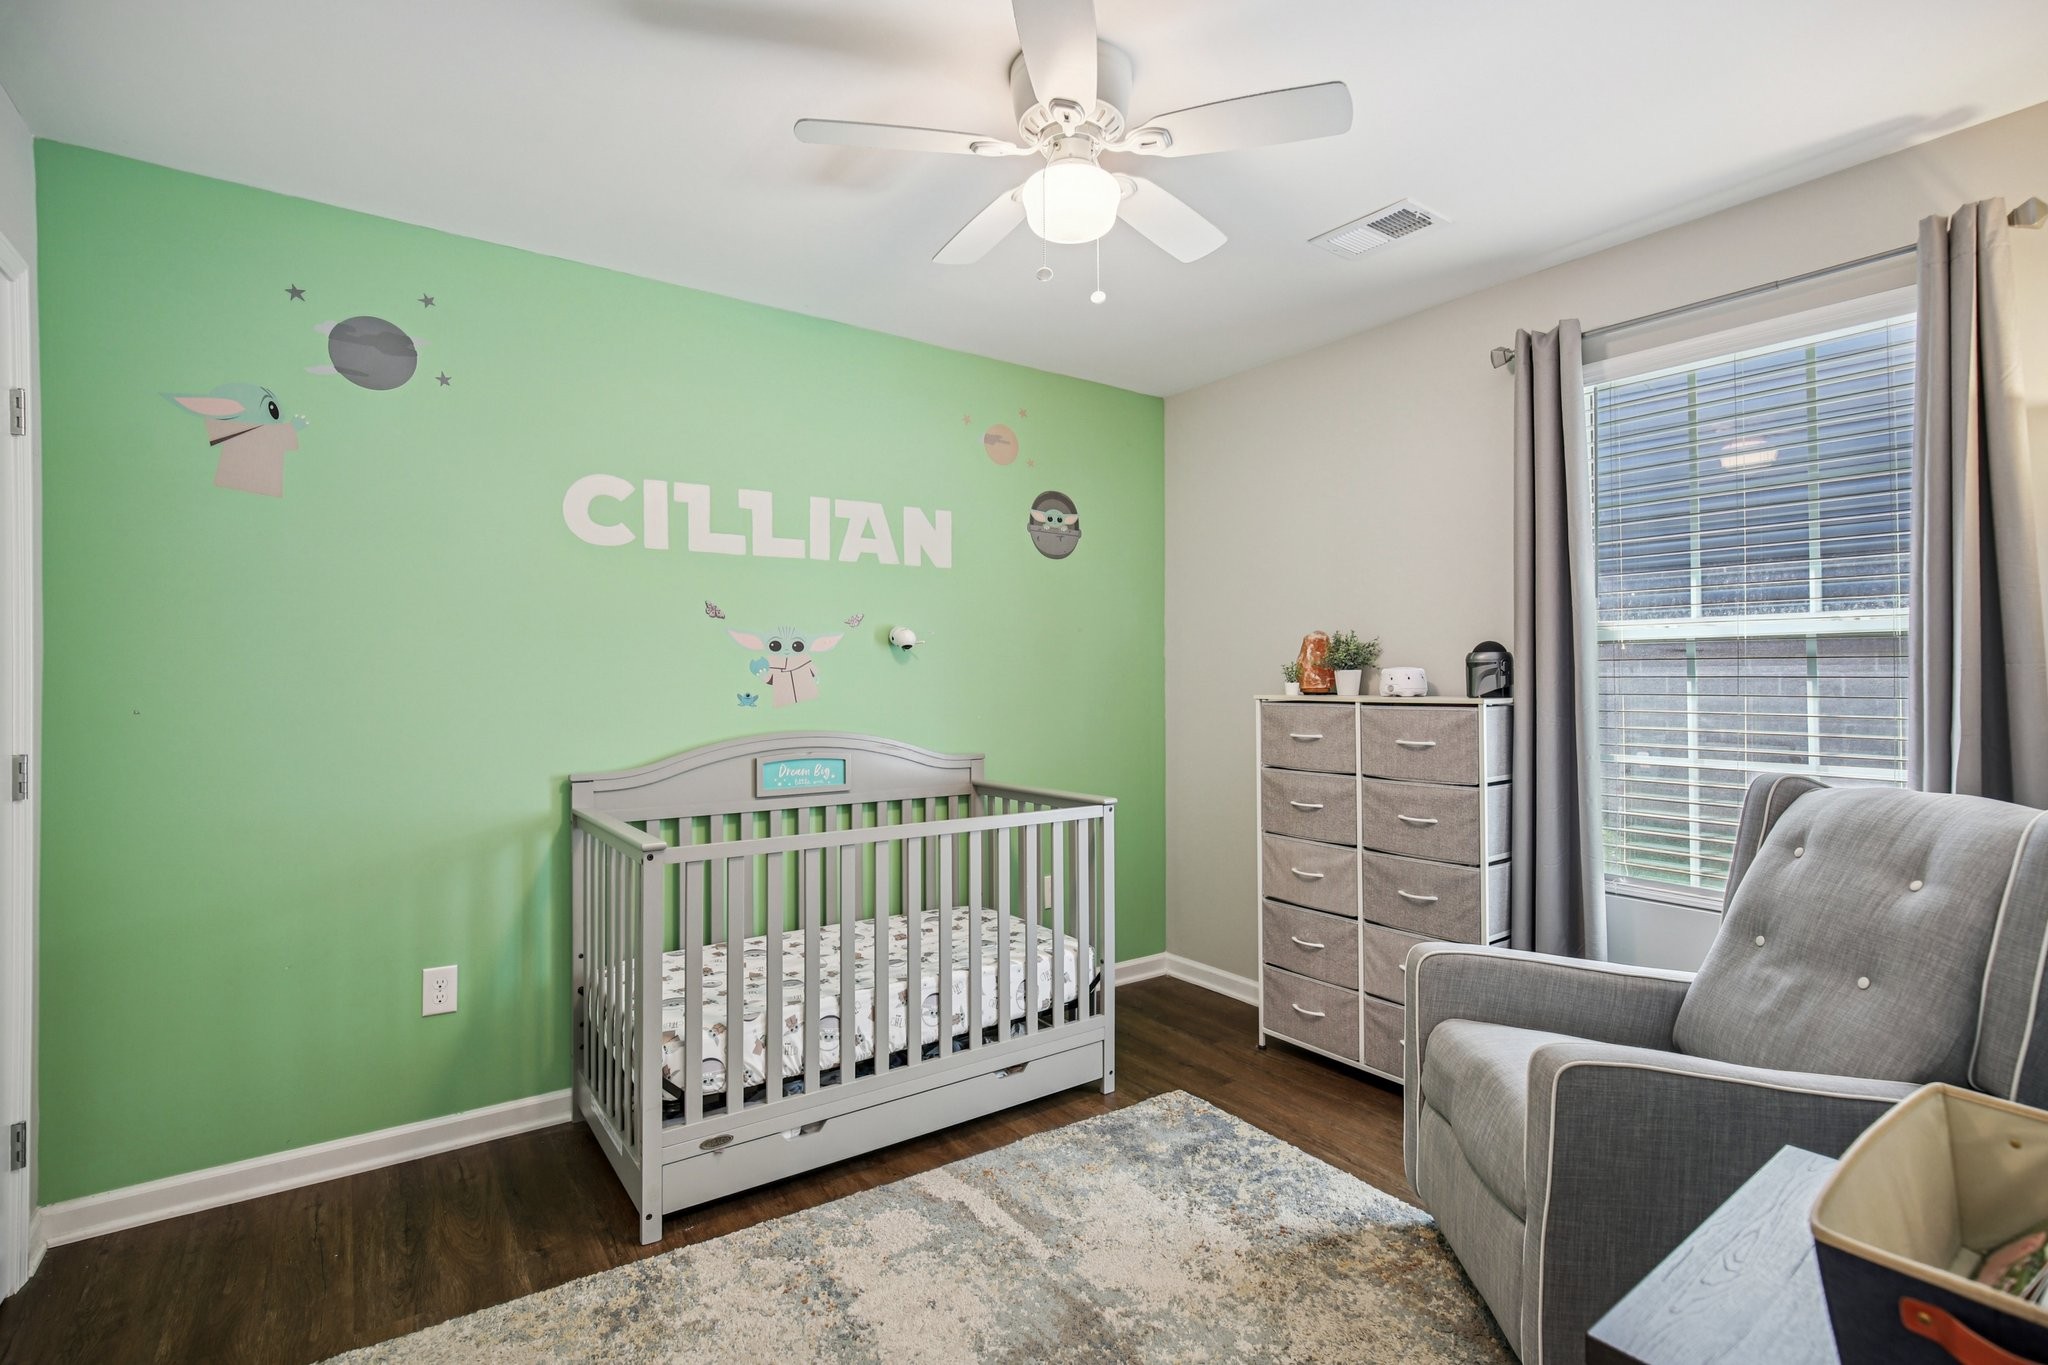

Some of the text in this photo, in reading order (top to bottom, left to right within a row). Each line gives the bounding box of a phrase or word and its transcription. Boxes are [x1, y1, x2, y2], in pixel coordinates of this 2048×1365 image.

[562, 473, 952, 568] CILLIAN
[779, 763, 831, 781] Dream Big
